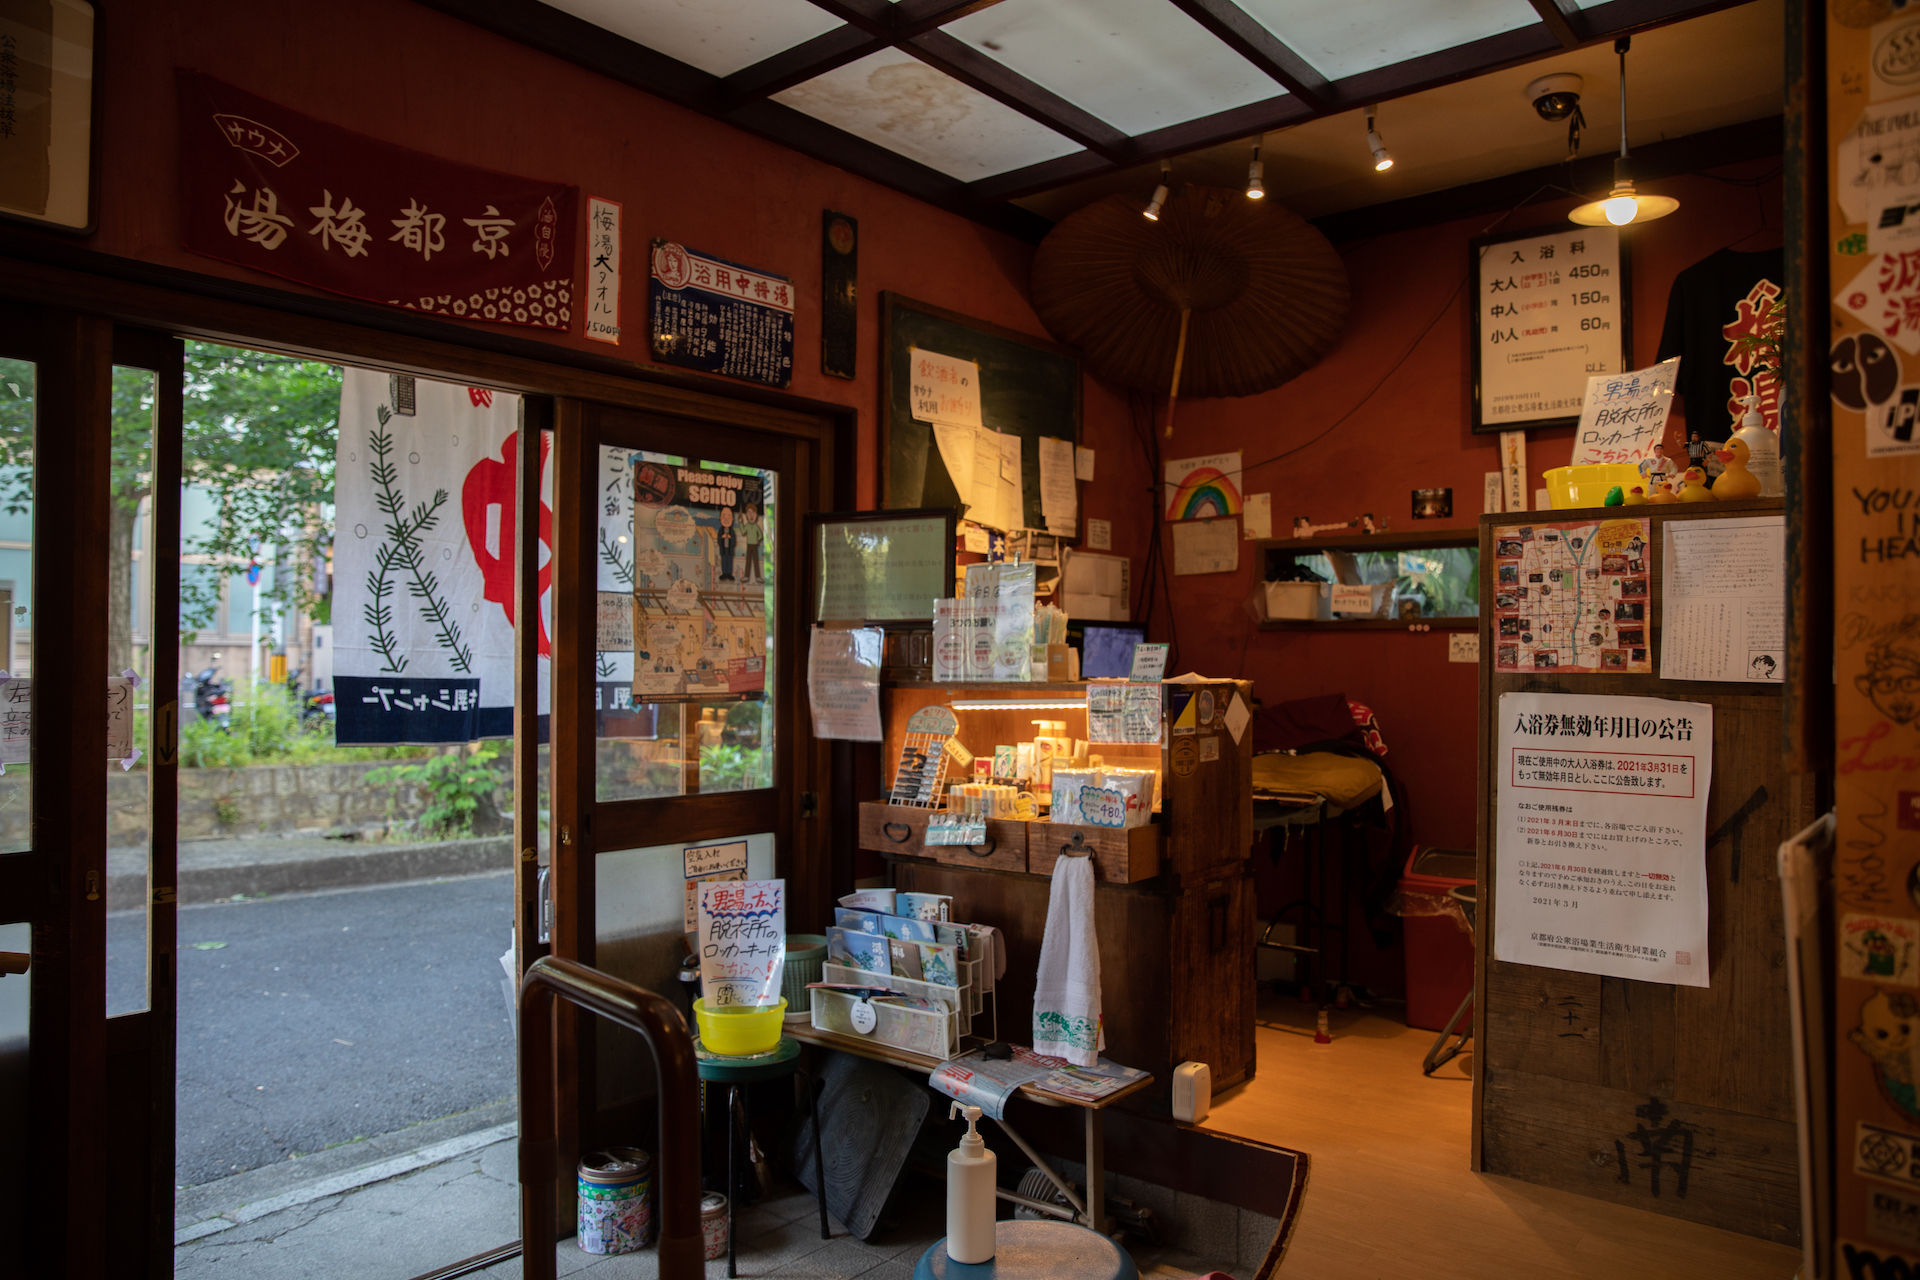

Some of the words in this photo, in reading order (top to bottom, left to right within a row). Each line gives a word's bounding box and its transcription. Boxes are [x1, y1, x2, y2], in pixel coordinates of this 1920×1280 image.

[226, 121, 286, 157] サウナ
[593, 204, 616, 315] 梅湯大タオル
[1510, 239, 1585, 264] 入浴料
[694, 262, 790, 306] 浴用中将湯
[1490, 276, 1518, 294] 大人
[1569, 263, 1609, 280] 450円
[1490, 302, 1518, 318] 中人
[1571, 291, 1610, 307] 150円
[586, 321, 620, 337] 1500円
[1490, 328, 1519, 344] 小人
[1580, 317, 1610, 332] 60円
[918, 359, 968, 387] 飲酒者の
[1595, 401, 1664, 428] 脱衣所の
[1583, 420, 1664, 446] ロッカーキーは
[676, 468, 716, 486] Please
[715, 474, 744, 491] enjoy
[688, 484, 737, 508] sento
[1514, 712, 1694, 741] 入浴券無効年月日の公告
[1517, 754, 1688, 775] 現在ご使用中の大人入浴券は、2021年3月31日を
[1518, 769, 1667, 789] もって無効年月日とし、ここに公告致します。
[1518, 802, 1573, 814] なおご使用残券は
[686, 848, 721, 863] 空気入れ
[712, 889, 775, 910] 男湯の方へ
[709, 919, 777, 941] 脱衣所の
[703, 942, 781, 959] ロッカーキーは
[1530, 932, 1668, 959] 京都府公衆浴場業生活衛生同業組合
